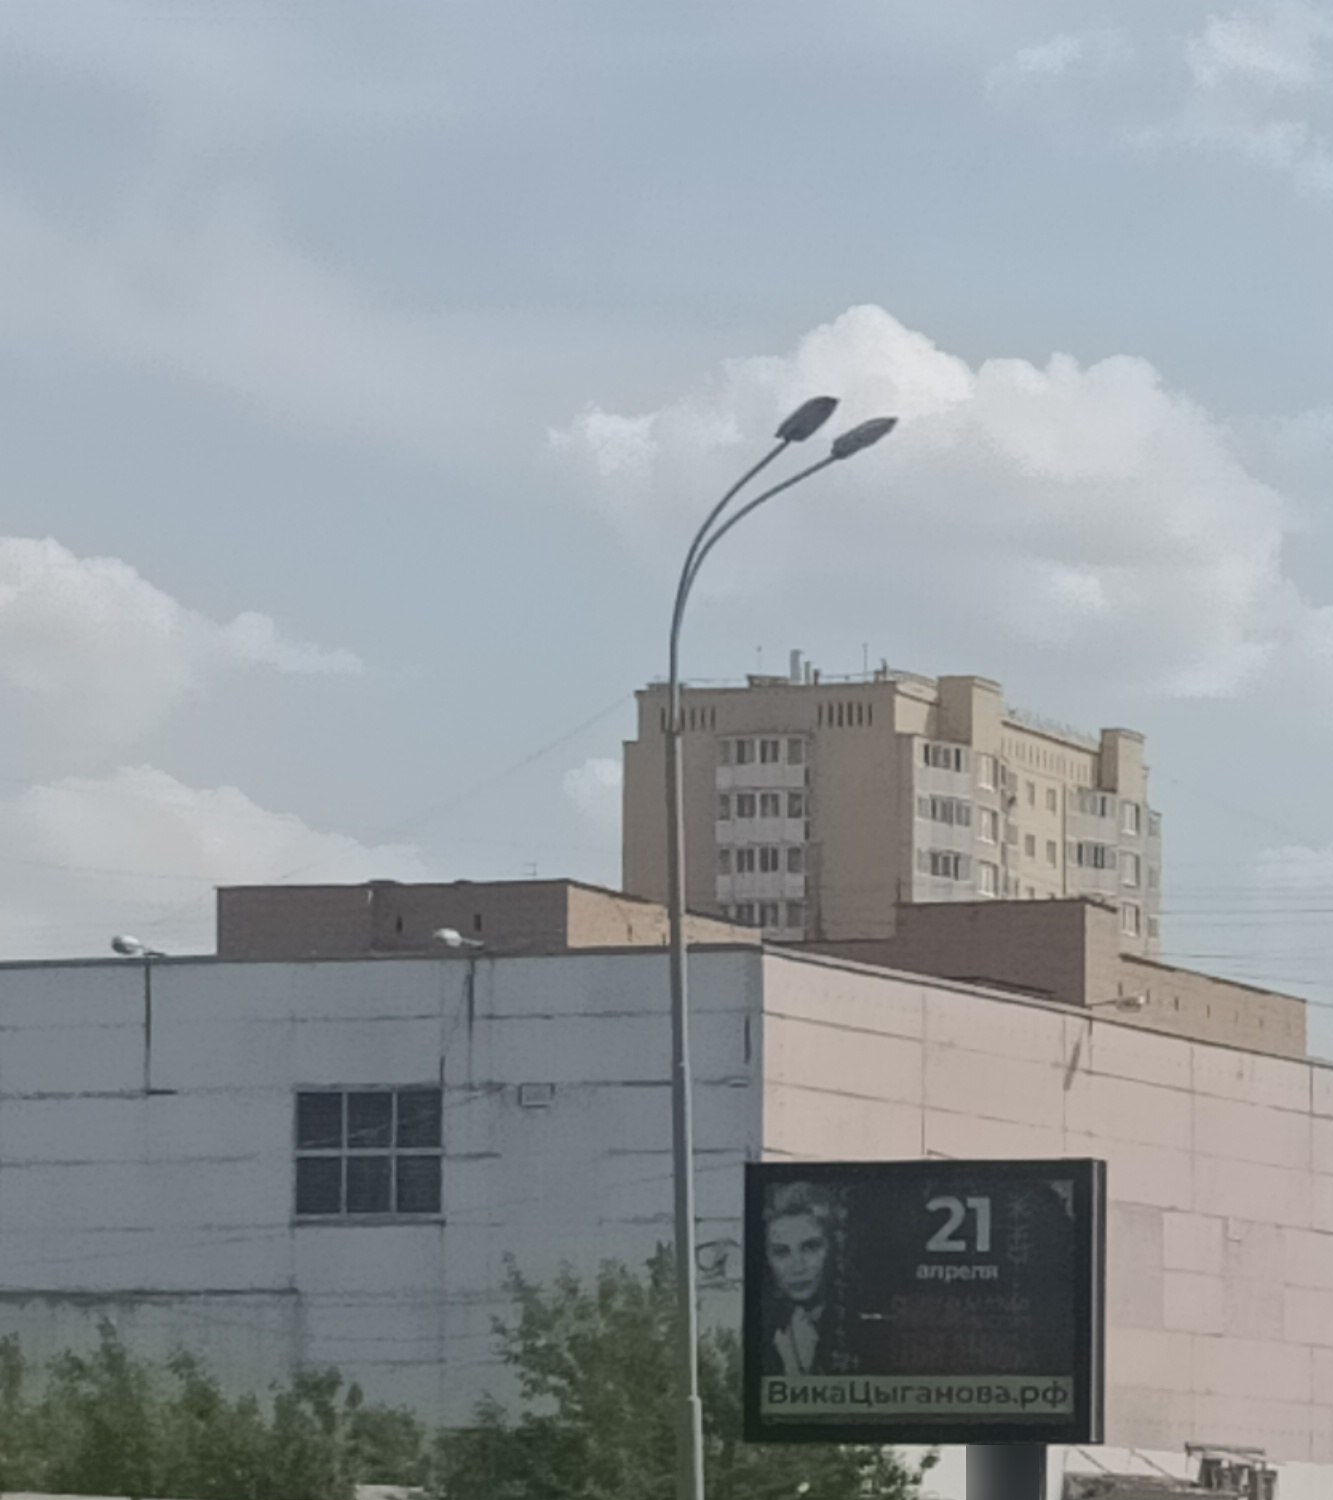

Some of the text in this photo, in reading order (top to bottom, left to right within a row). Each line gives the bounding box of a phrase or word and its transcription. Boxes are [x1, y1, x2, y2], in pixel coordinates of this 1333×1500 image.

[925, 1196, 991, 1252] 21
[916, 1264, 999, 1283] апреля
[767, 1380, 1069, 1409] ВикаЦыганова.рф
